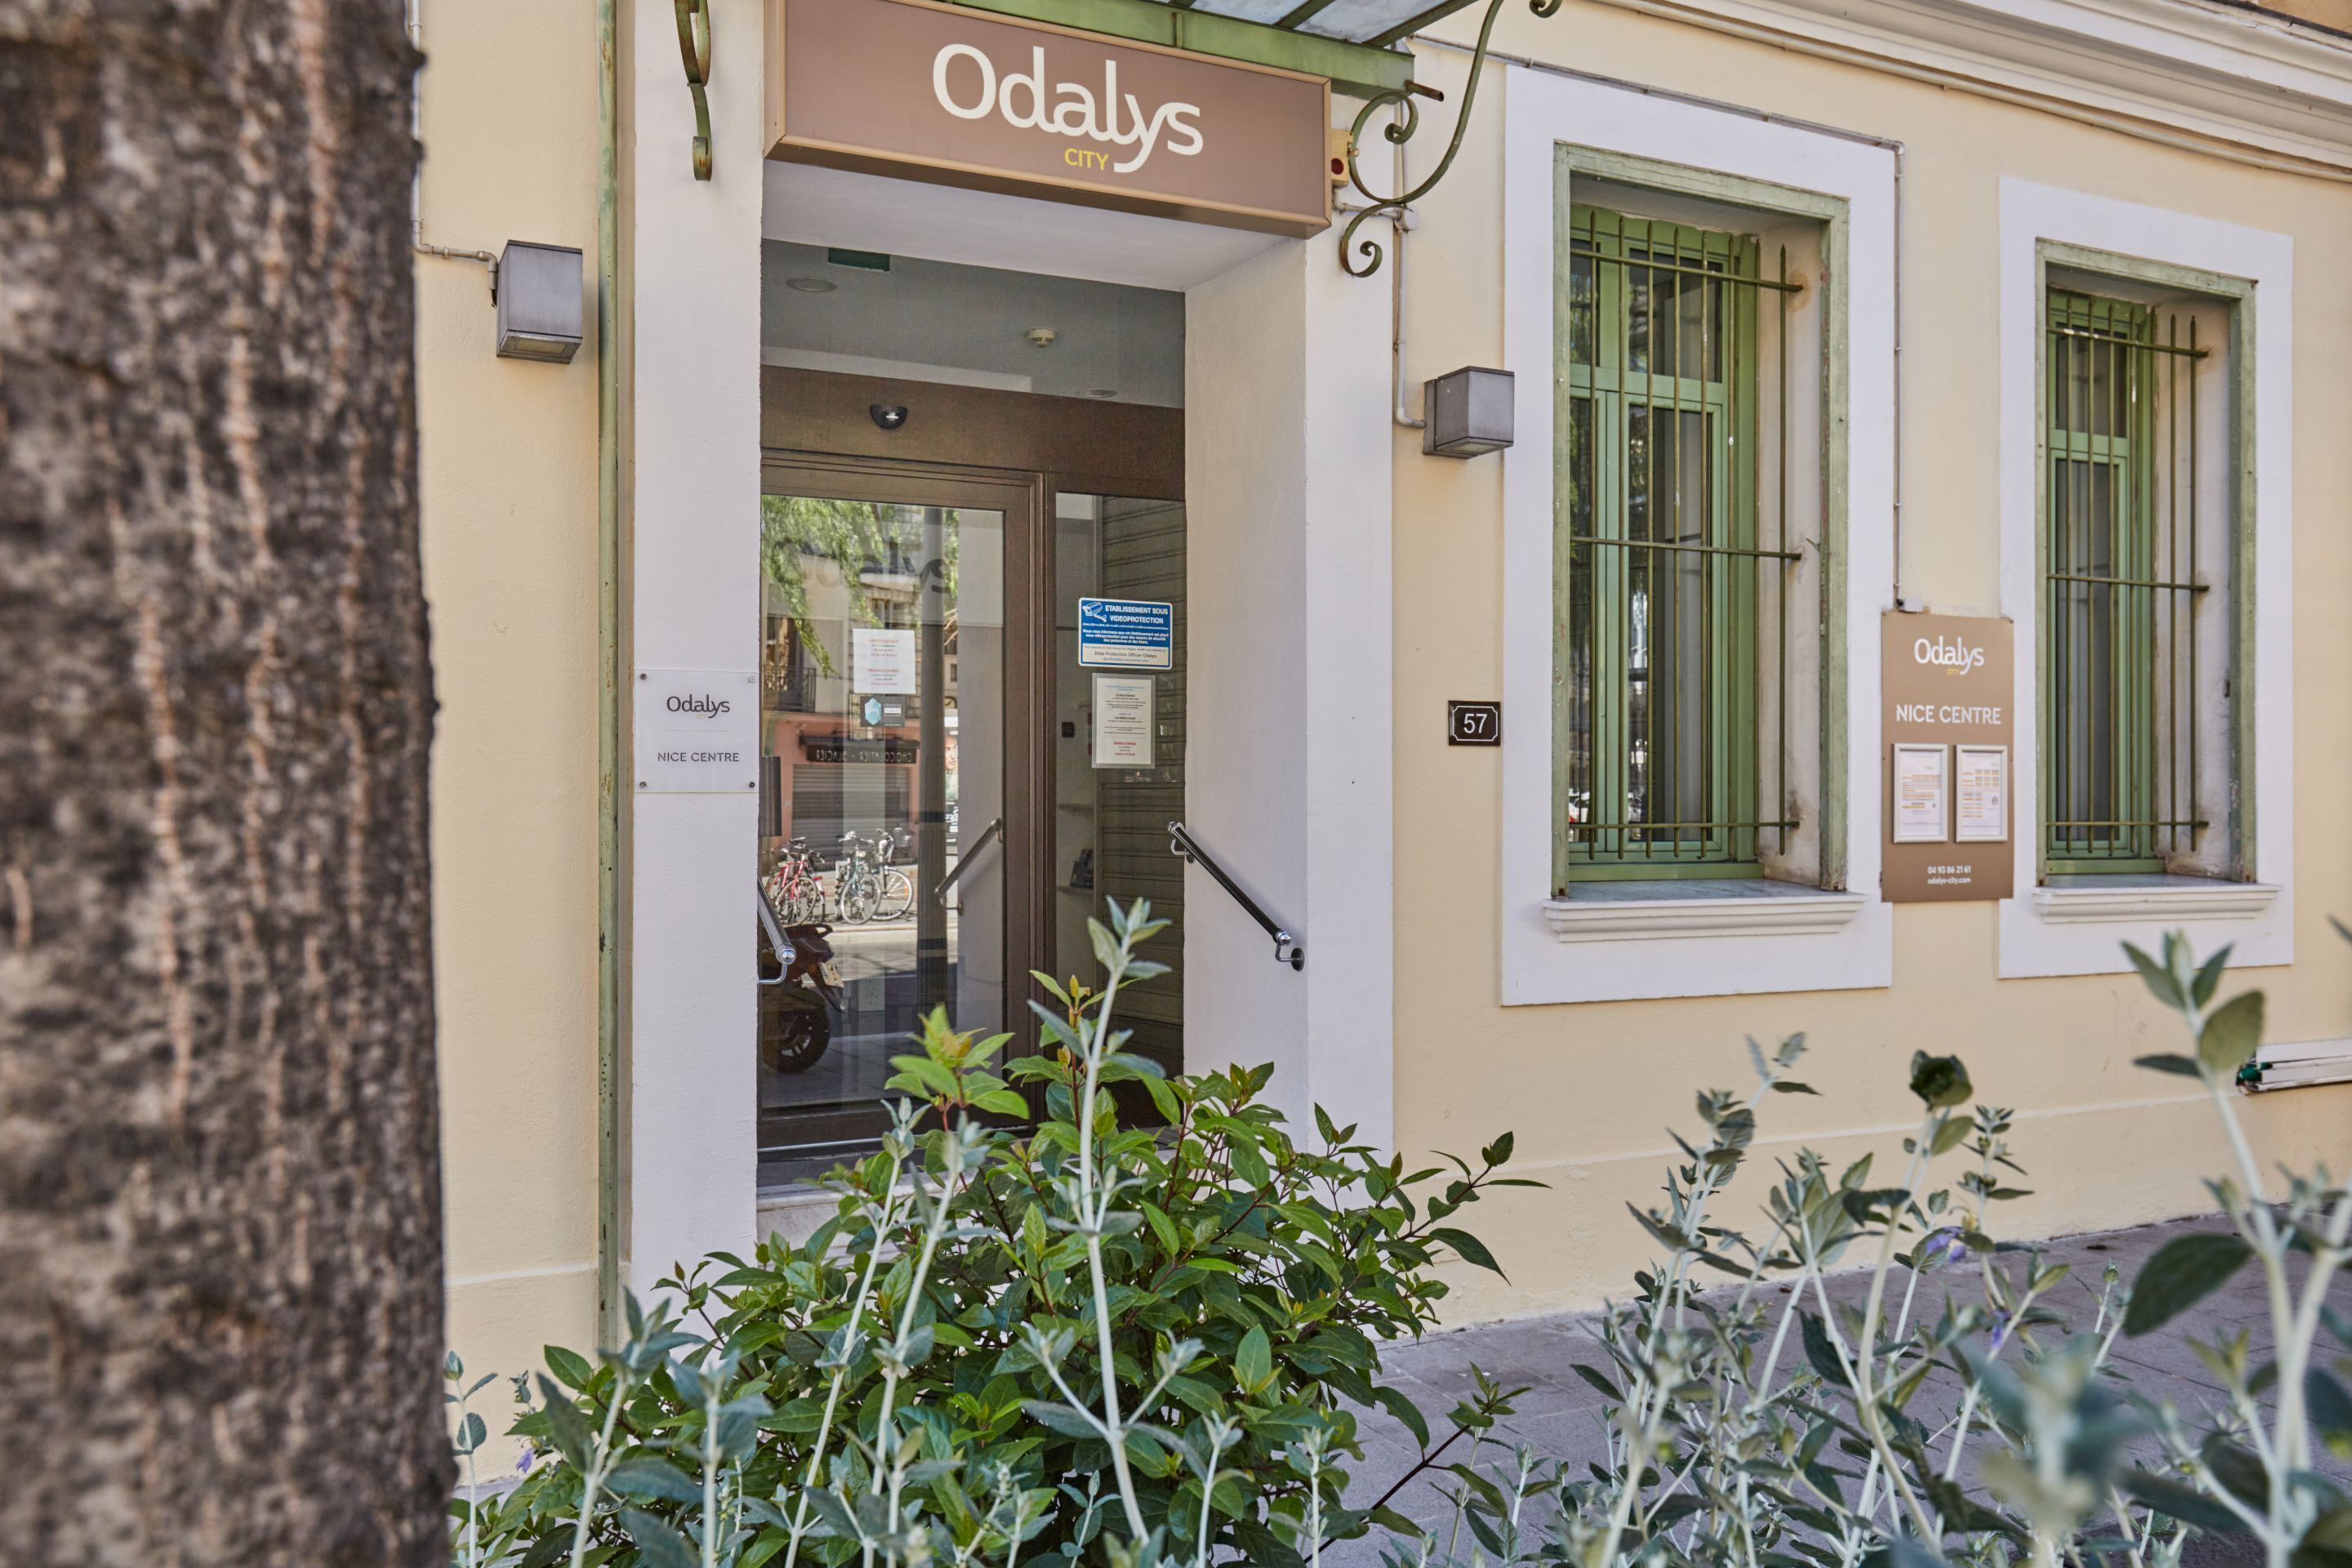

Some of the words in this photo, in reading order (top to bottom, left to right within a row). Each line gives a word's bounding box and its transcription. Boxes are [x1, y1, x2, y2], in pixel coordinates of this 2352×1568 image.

[932, 42, 1204, 173] Odalys
[1064, 148, 1109, 171] CITY
[1105, 605, 1151, 614] ETABLISSEMENT
[1109, 615, 1164, 624] VIDEOPROTECTION
[1914, 635, 1984, 675] Odalys
[666, 694, 730, 719] Odalys
[1896, 704, 1936, 723] NICE
[1939, 706, 2002, 724] CENTRE
[1463, 713, 1487, 733] 57
[657, 752, 687, 762] NICE
[691, 752, 740, 762] CENTRE
[1927, 866, 1936, 874] 04
[1937, 866, 1945, 874] 93
[1956, 865, 1963, 874] 21
